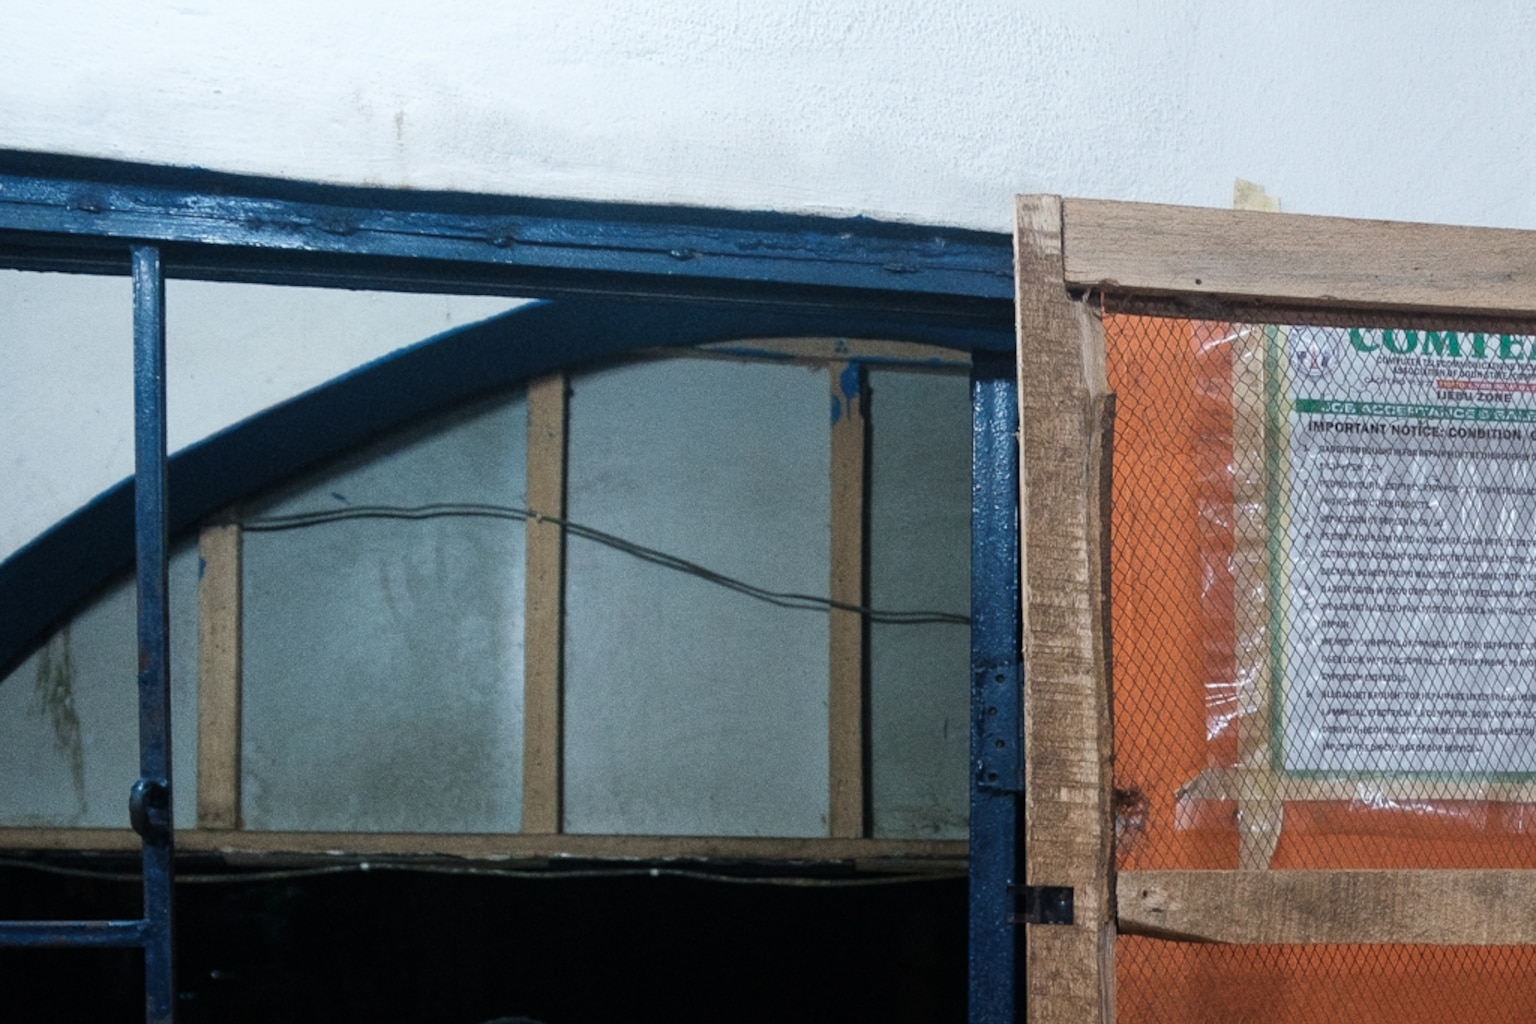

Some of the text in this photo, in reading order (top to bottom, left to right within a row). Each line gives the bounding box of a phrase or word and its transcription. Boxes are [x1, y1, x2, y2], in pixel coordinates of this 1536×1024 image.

[1437, 391, 1512, 403] IJEBU ZONE
[1321, 402, 1356, 413] JOB
[1361, 403, 1475, 420] ACCEPTANCE
[1308, 420, 1387, 435] IMPORTANT
[1391, 424, 1444, 438] NOTICE:
[1447, 426, 1522, 441] CONDITION
